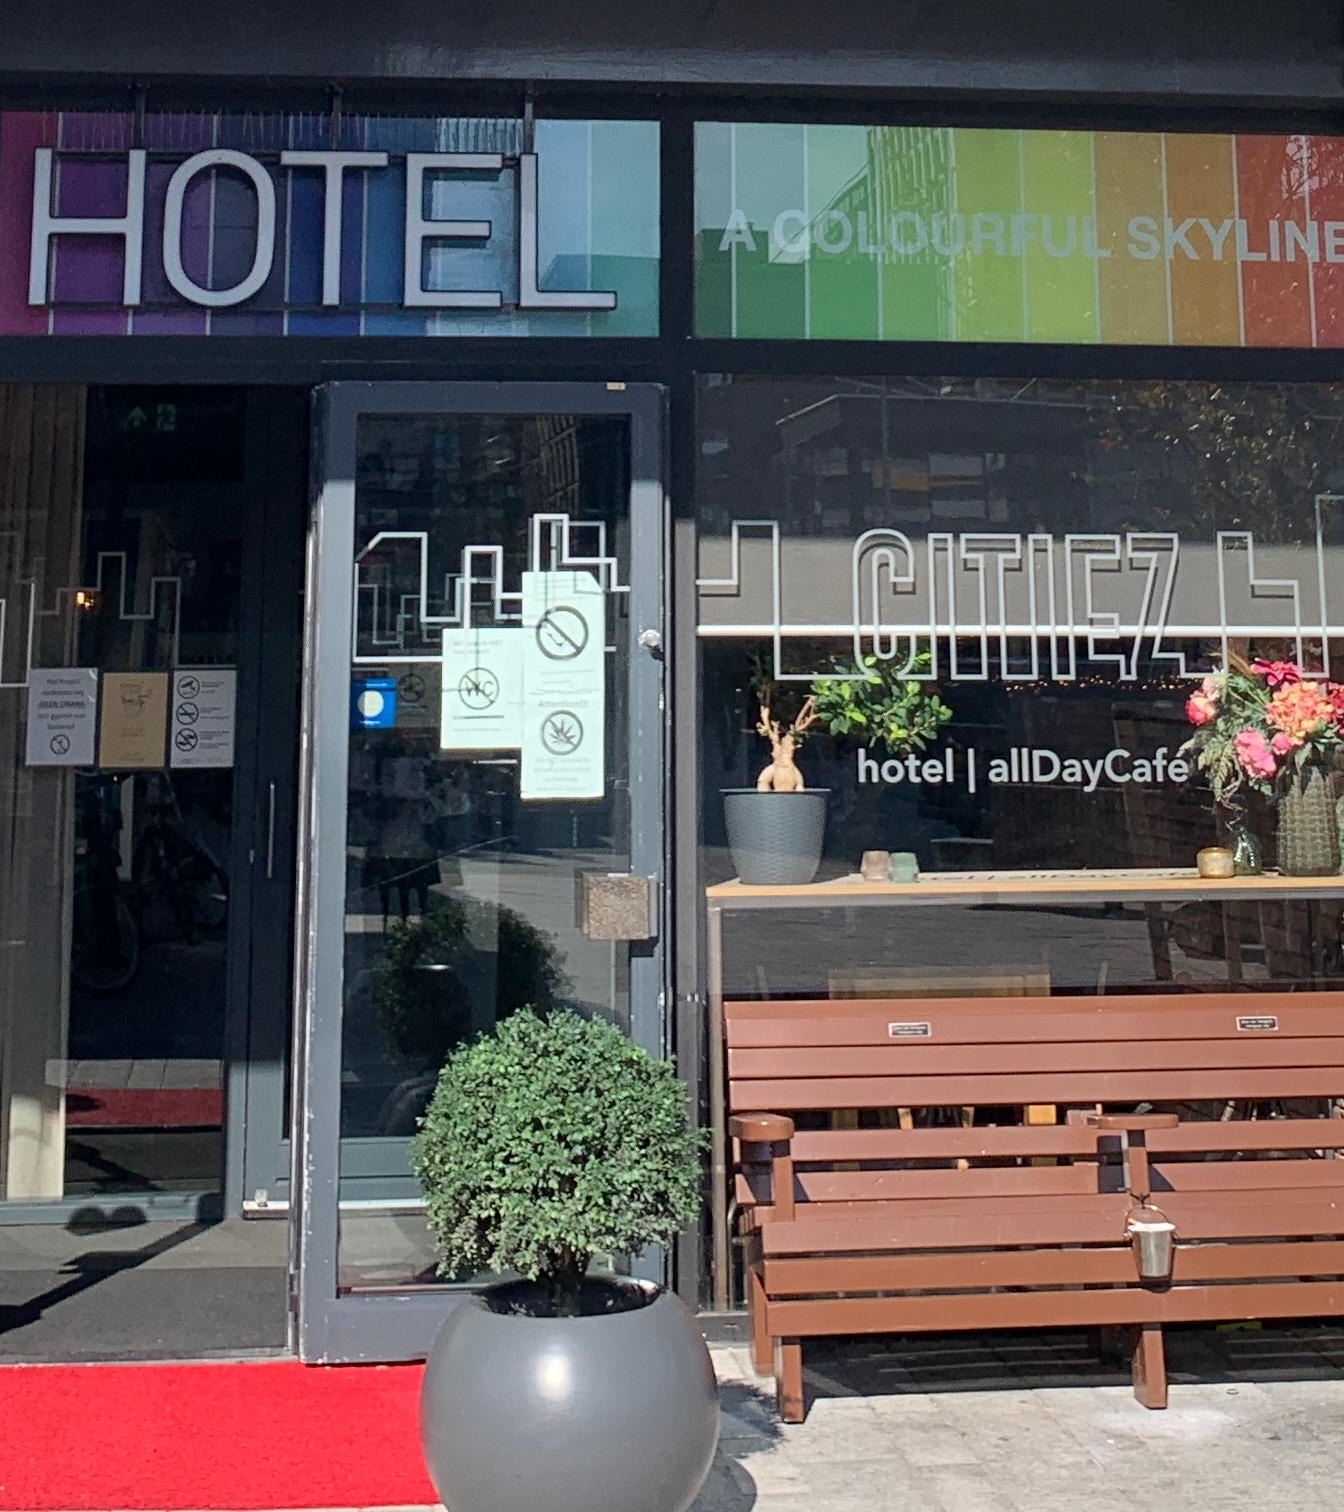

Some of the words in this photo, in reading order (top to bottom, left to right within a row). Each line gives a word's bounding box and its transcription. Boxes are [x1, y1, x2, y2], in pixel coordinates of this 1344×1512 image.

[27, 148, 617, 310] HOTEL
[718, 208, 756, 252] A
[767, 209, 1111, 259] COLOURFUL
[852, 528, 1185, 680] CITIEZ
[857, 747, 954, 784] hotel
[987, 746, 1191, 793] allDayCafé
